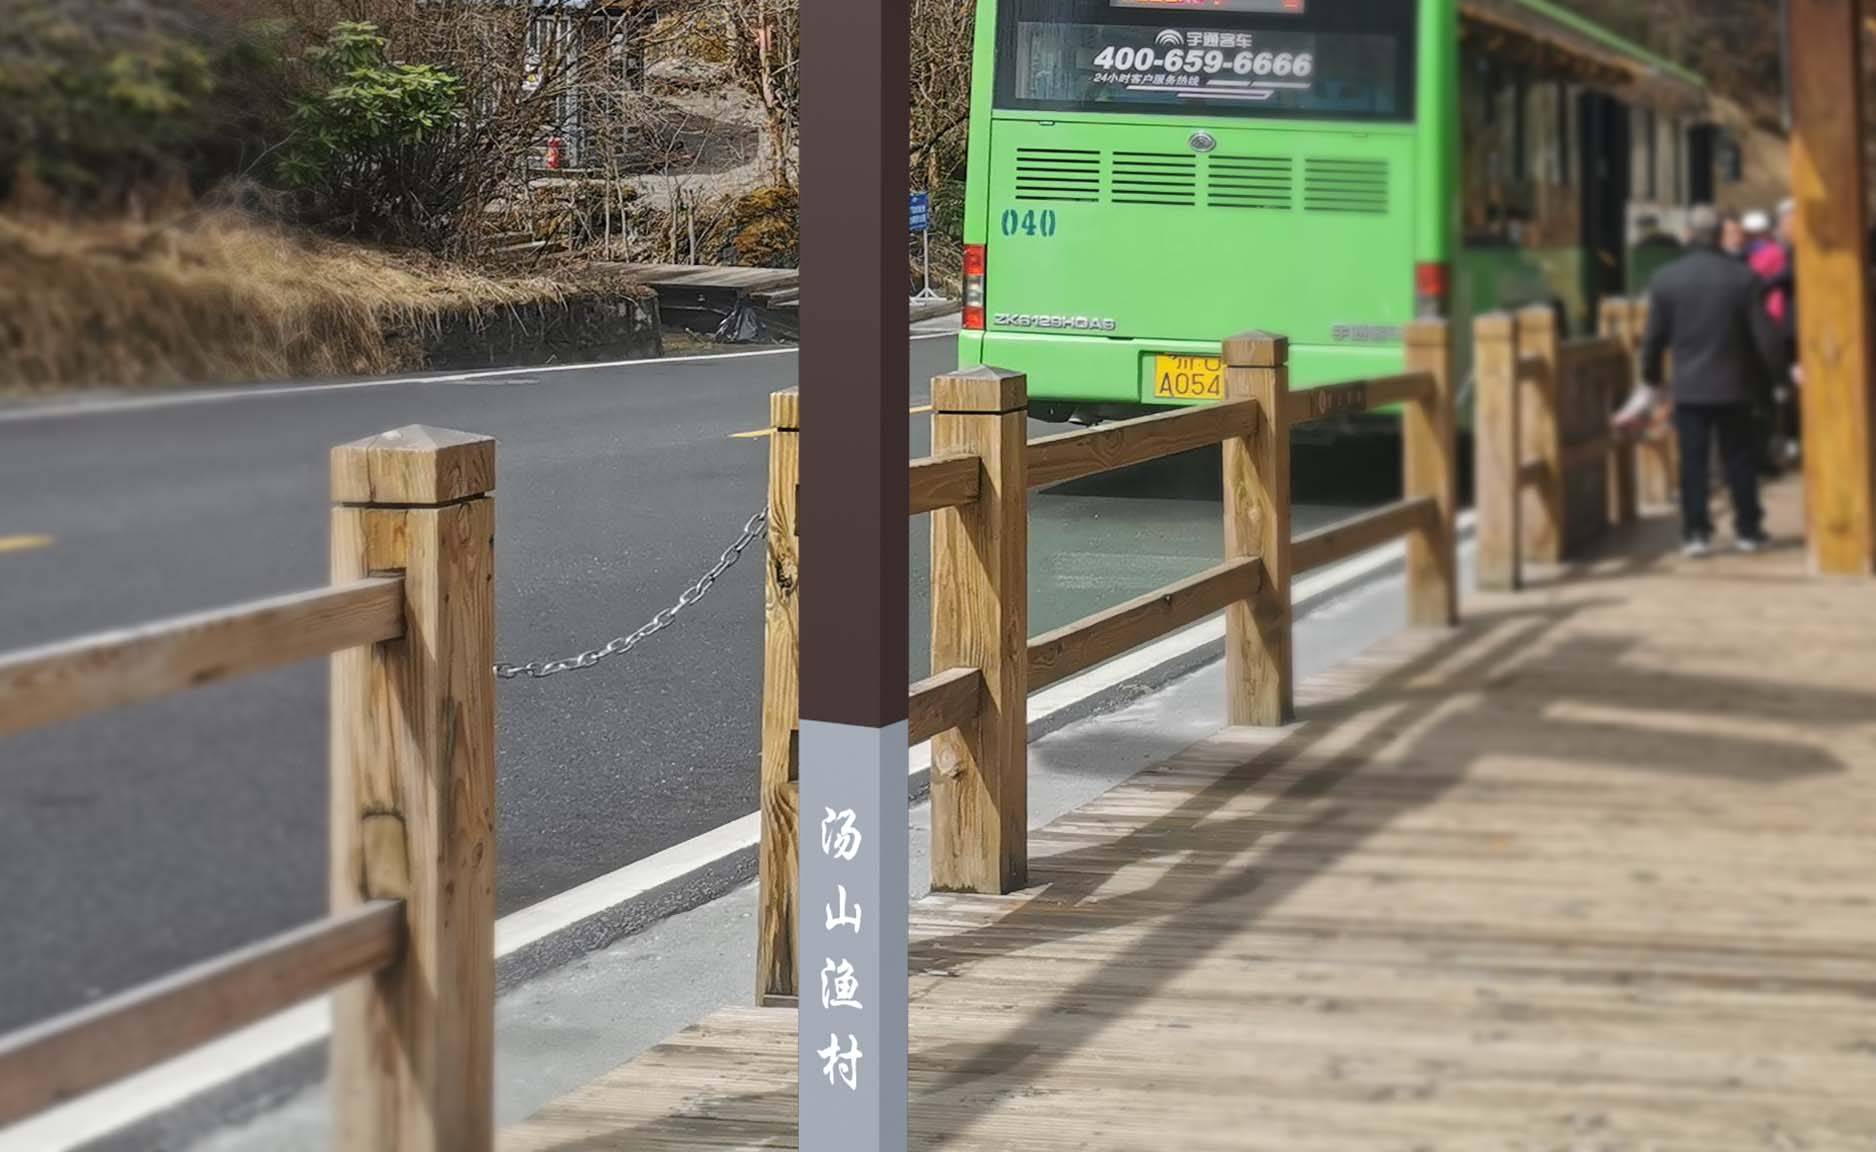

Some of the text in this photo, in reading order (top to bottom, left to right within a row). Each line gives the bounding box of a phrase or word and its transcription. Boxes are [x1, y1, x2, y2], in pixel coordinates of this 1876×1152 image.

[1187, 32, 1253, 48] 宇通客车
[1094, 47, 1313, 77] 400-659-6666
[1001, 209, 1056, 237] 040
[1160, 372, 1220, 396] A054
[816, 807, 863, 1090] 汤山渔村
